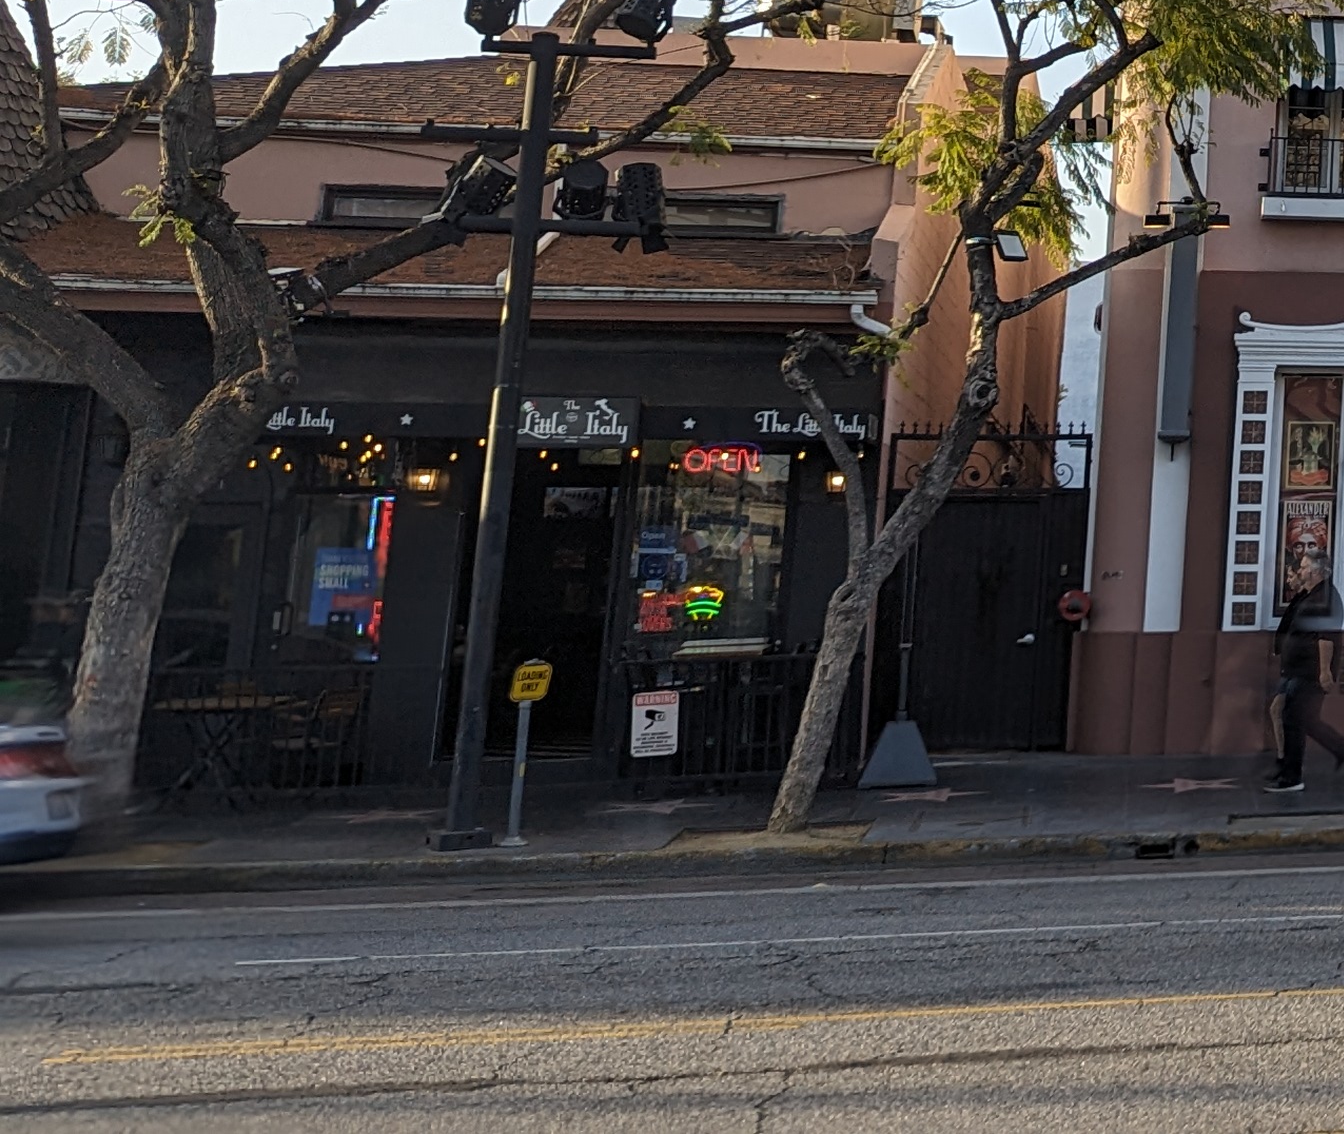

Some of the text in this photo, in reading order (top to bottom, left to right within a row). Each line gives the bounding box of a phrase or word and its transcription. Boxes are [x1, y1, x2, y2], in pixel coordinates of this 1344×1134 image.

[266, 406, 335, 435] ttle Italy
[517, 410, 628, 443] Little Italy
[754, 409, 790, 433] The
[792, 413, 821, 437] Litt
[684, 449, 760, 474] OPEN
[1286, 502, 1330, 516] ALEXANDER
[319, 564, 369, 577] SHOPPING
[318, 577, 349, 589] SMALL
[517, 669, 549, 682] LOADING
[520, 681, 541, 692] ONLY
[636, 691, 678, 706] WARNING
